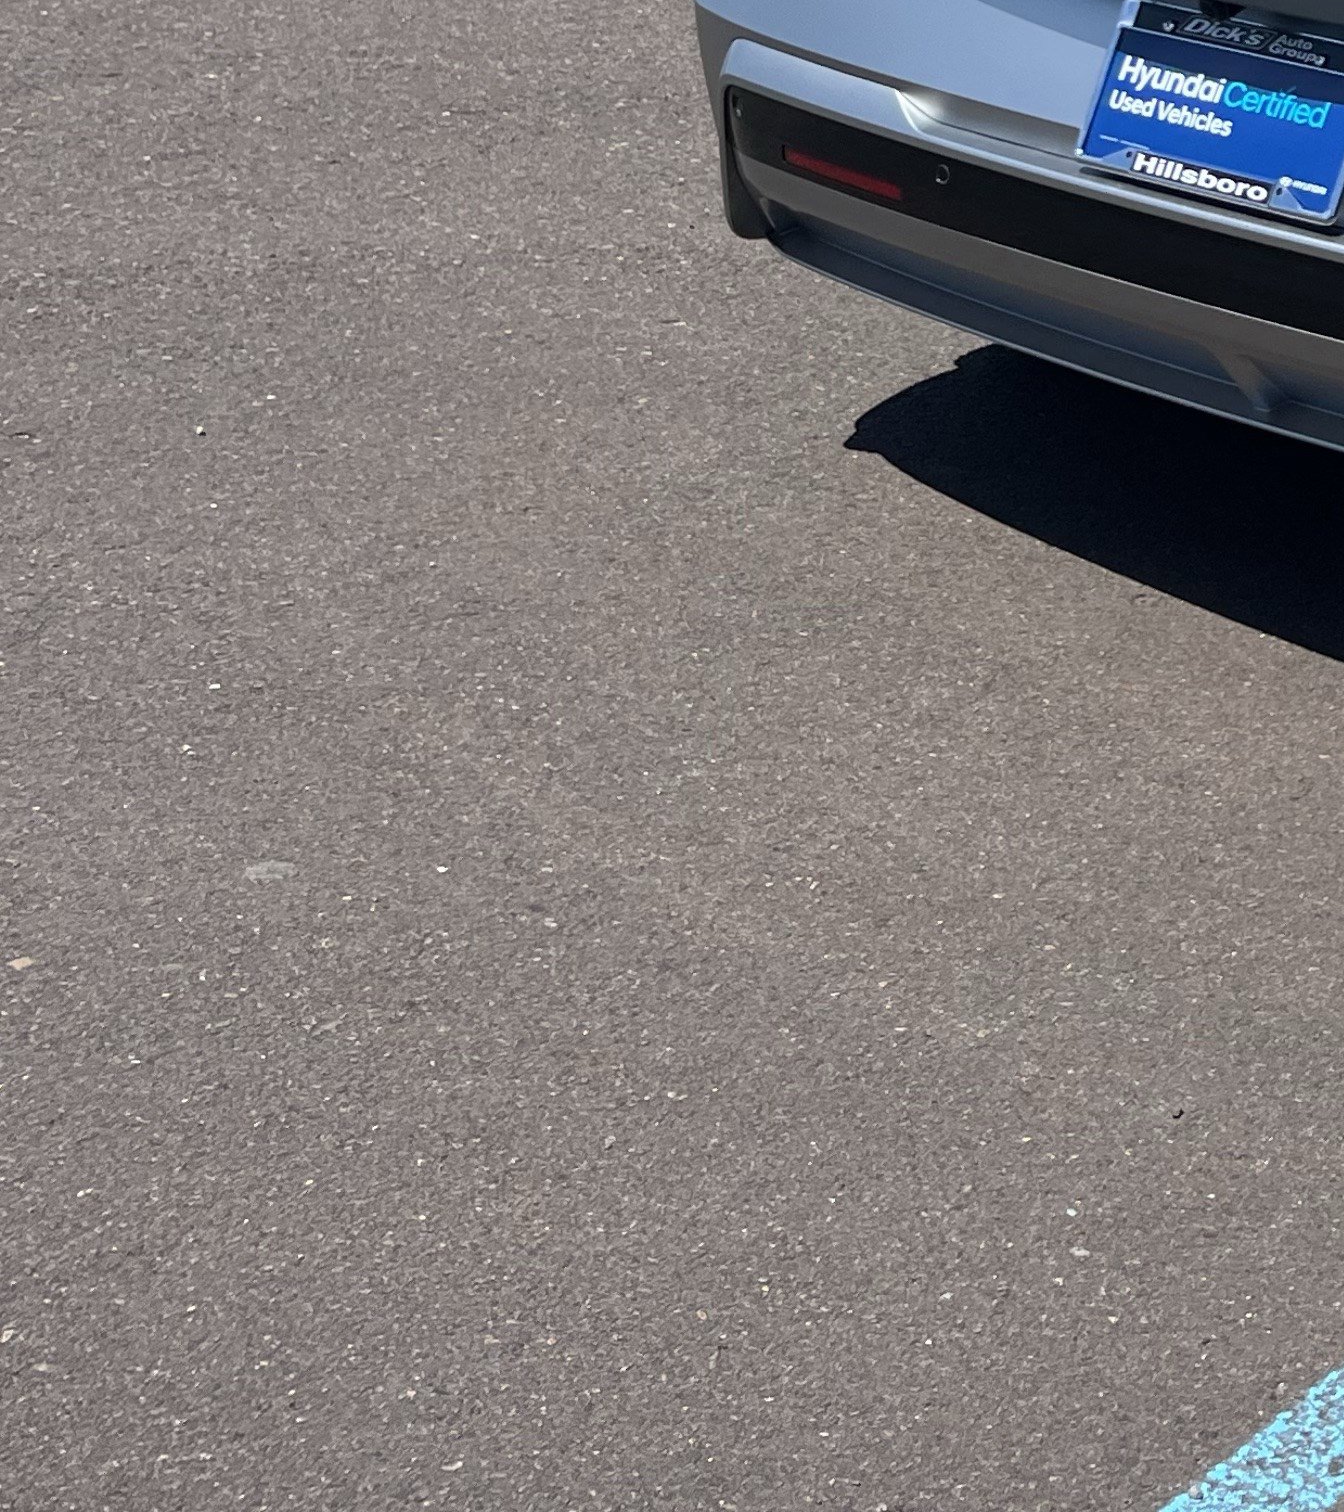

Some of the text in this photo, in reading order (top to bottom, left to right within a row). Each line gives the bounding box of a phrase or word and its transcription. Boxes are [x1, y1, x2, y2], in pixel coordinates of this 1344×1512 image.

[1184, 18, 1265, 47] Dick's
[1277, 35, 1313, 50] Auto
[1109, 90, 1233, 137] Used Vehicles
[1133, 152, 1268, 201] Hillsboro
